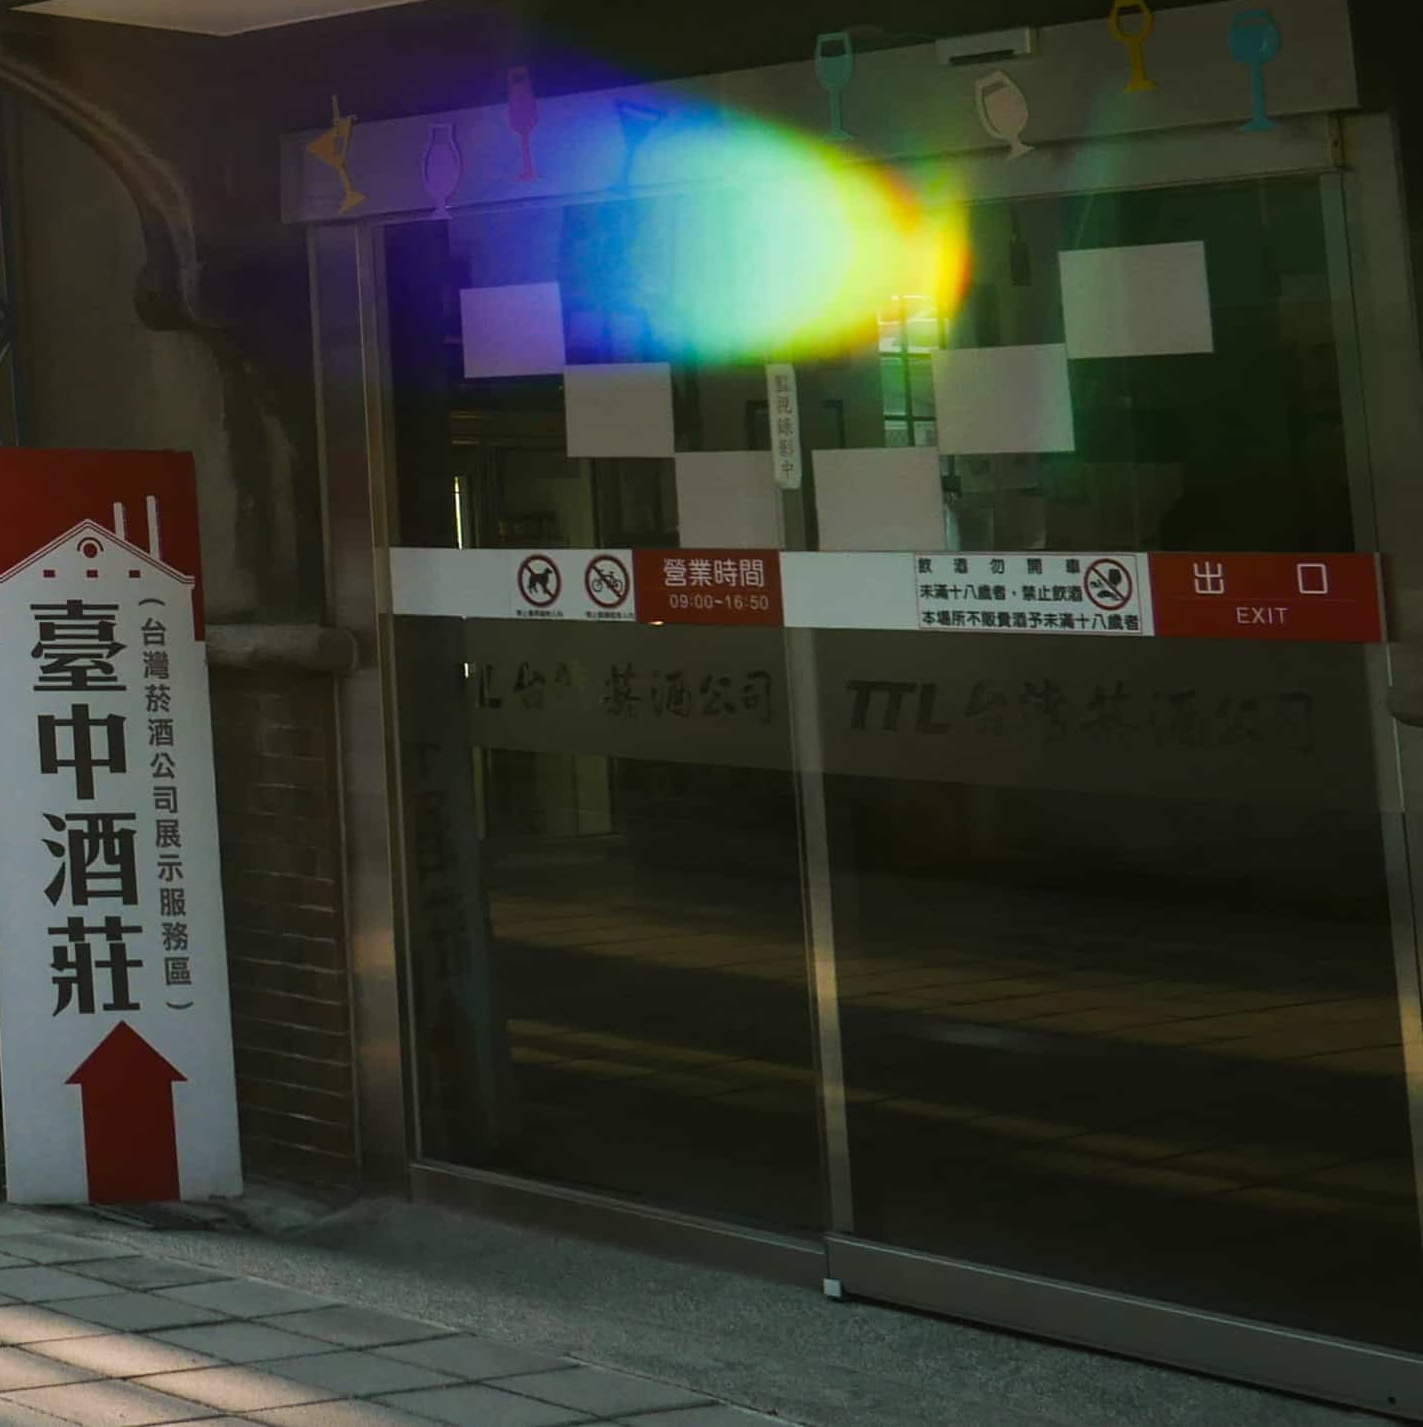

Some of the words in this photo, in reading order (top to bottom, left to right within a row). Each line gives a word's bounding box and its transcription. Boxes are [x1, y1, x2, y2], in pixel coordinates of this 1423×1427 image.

[662, 557, 765, 590] 營業時間
[1193, 560, 1329, 595] 出口
[1236, 606, 1289, 625] EXIT
[844, 678, 953, 734] TTL
[30, 599, 144, 1017] 臺中酒莊
